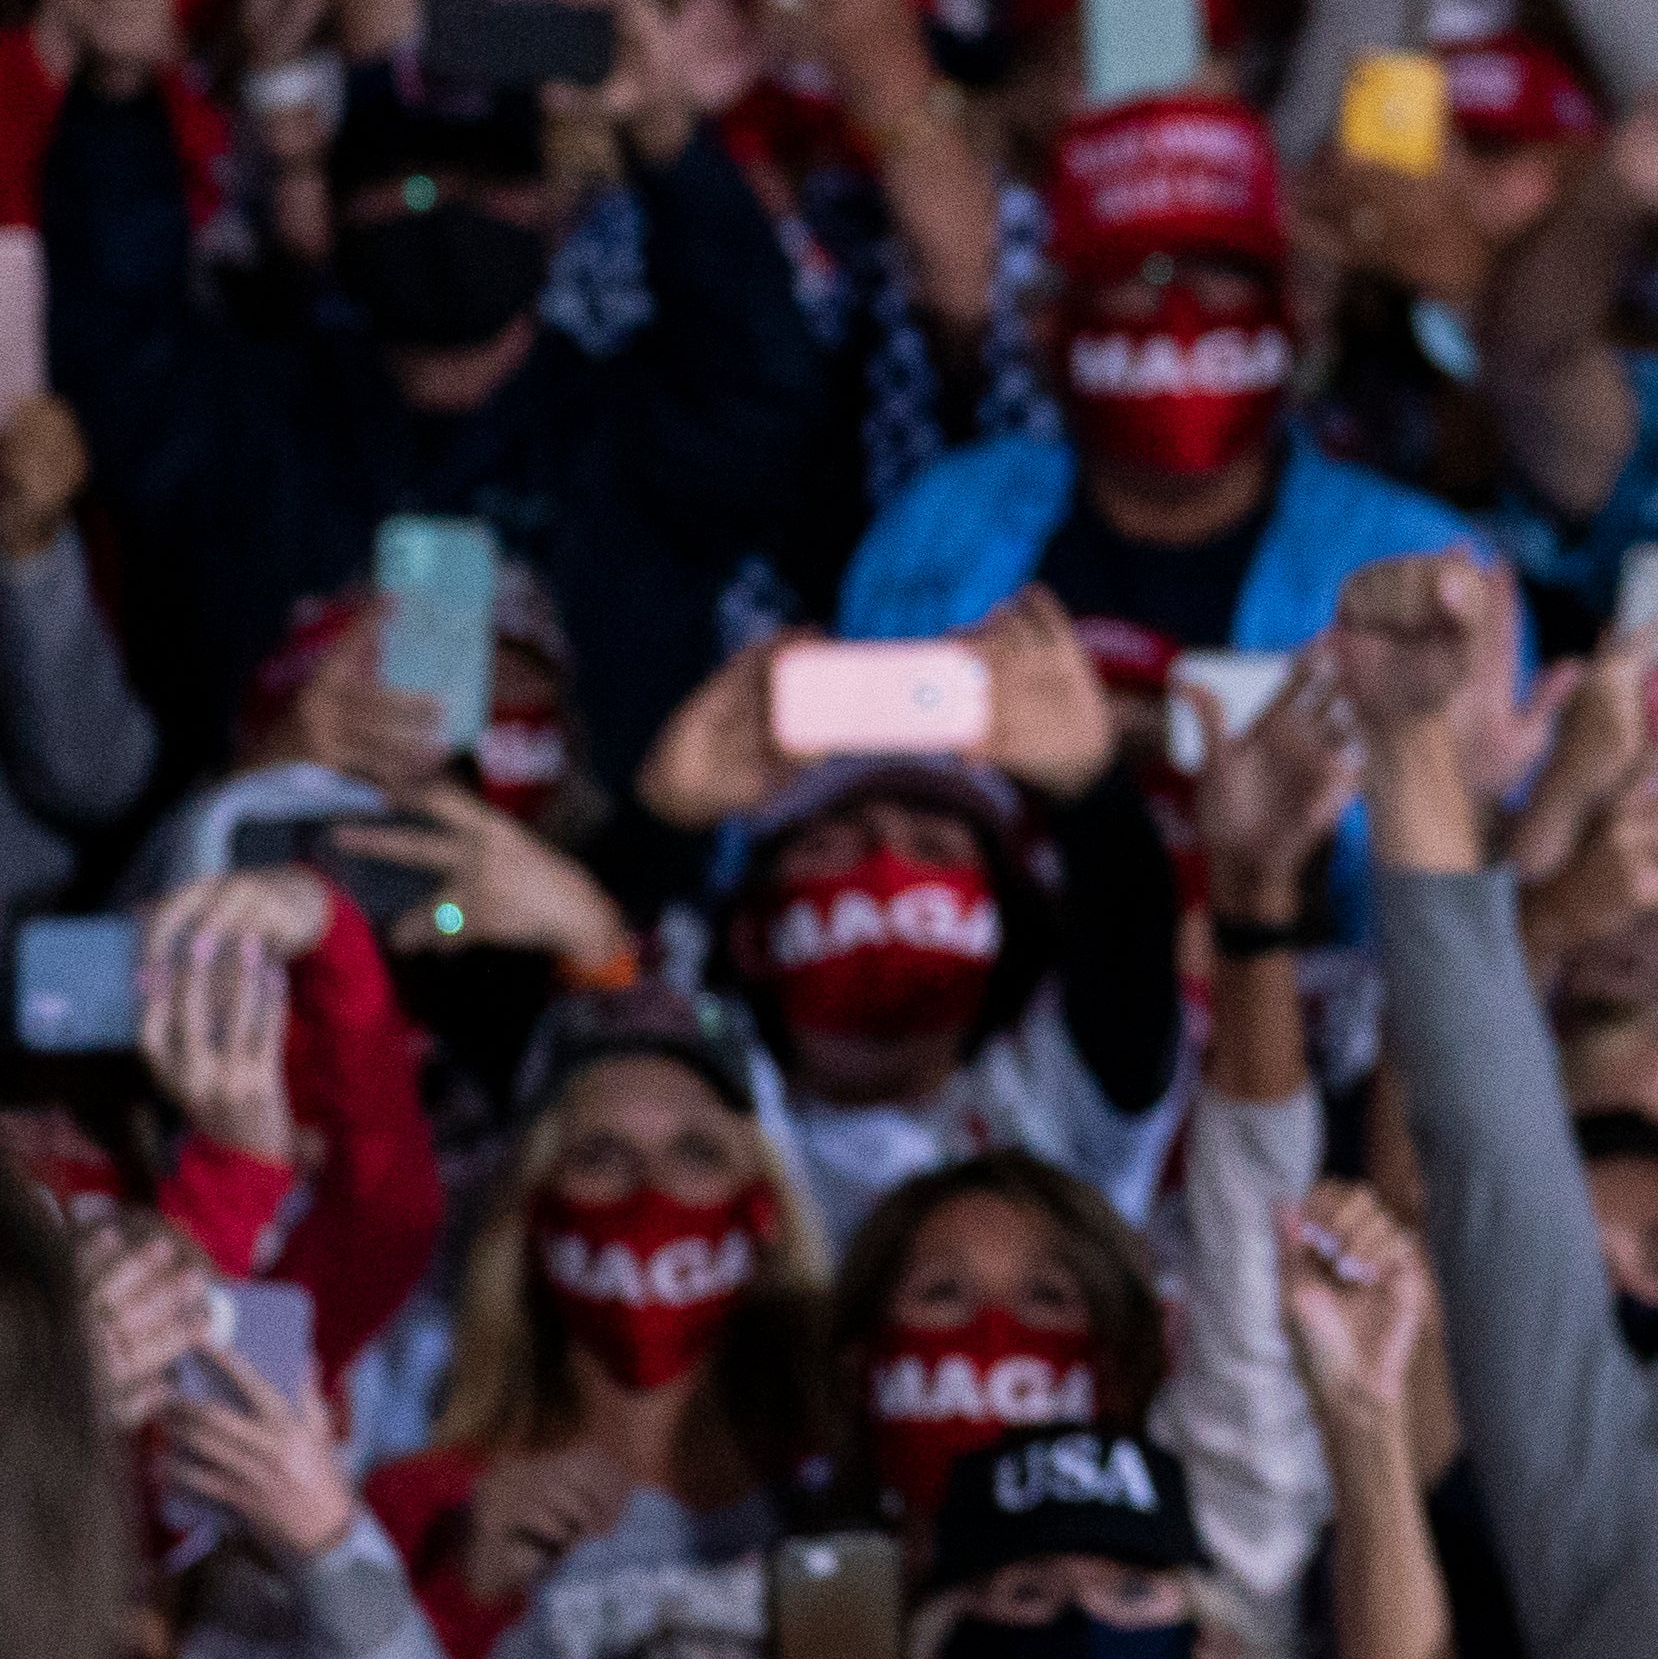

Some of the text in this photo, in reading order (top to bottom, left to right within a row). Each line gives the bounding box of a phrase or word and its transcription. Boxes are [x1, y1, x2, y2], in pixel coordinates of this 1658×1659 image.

[1070, 329, 1290, 394] MAGA
[874, 1354, 1096, 1425] MAGA
[992, 1432, 1160, 1514] USA
